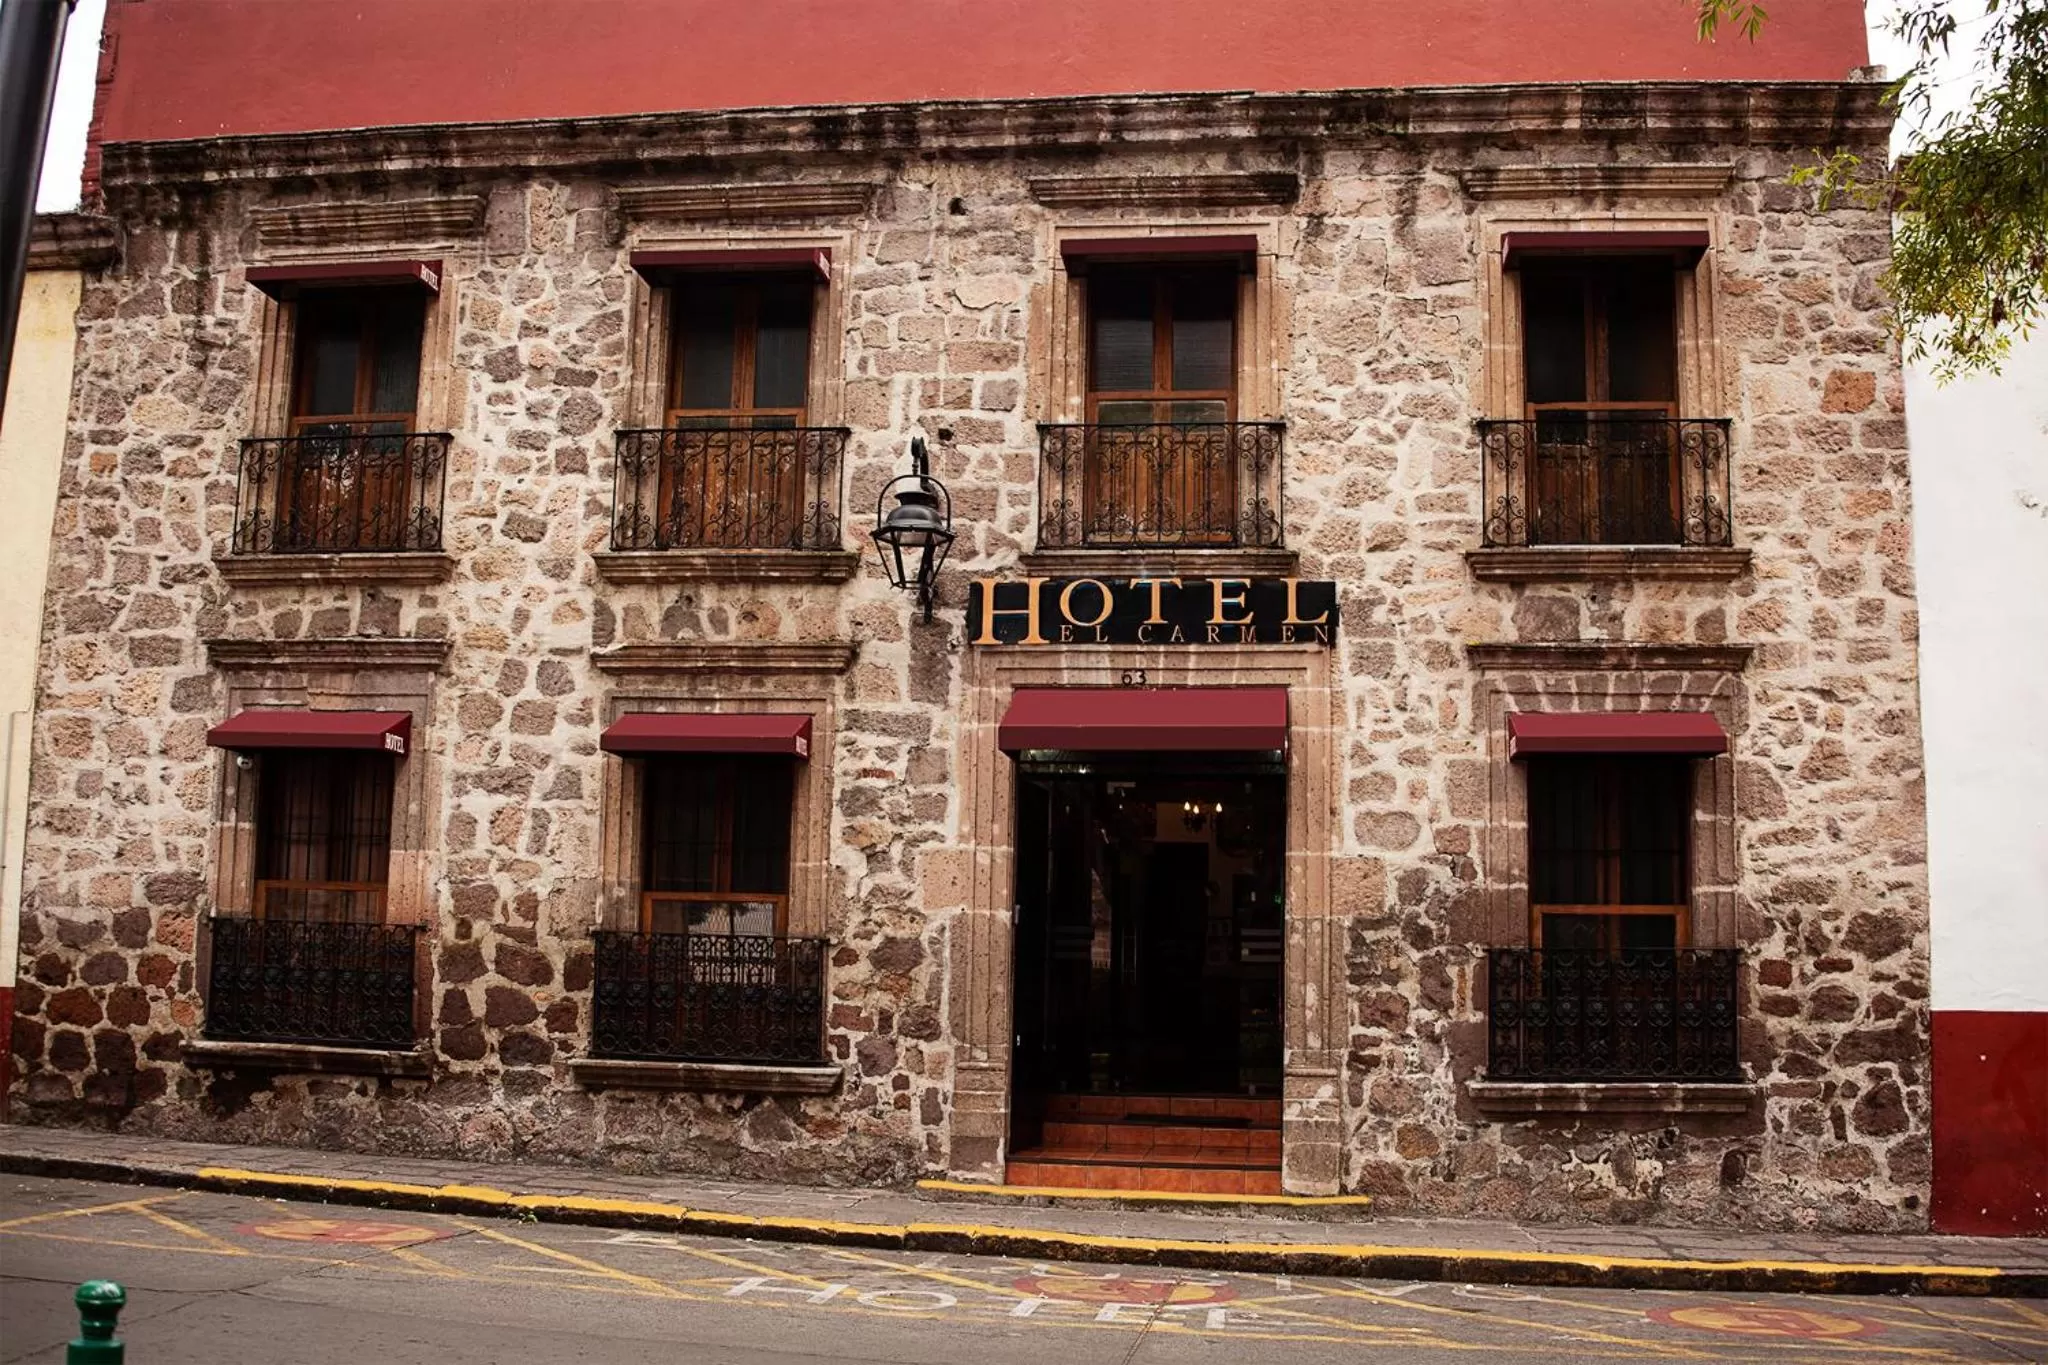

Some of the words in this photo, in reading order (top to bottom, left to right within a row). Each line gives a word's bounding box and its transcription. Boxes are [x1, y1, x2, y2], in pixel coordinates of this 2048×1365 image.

[971, 577, 1330, 646] HOTEL
[1058, 624, 1109, 643] EL
[1137, 623, 1330, 644] CARMEN
[1121, 669, 1147, 686] 63
[384, 732, 405, 754] HOTEL
[720, 1275, 1285, 1330] HOTEL
